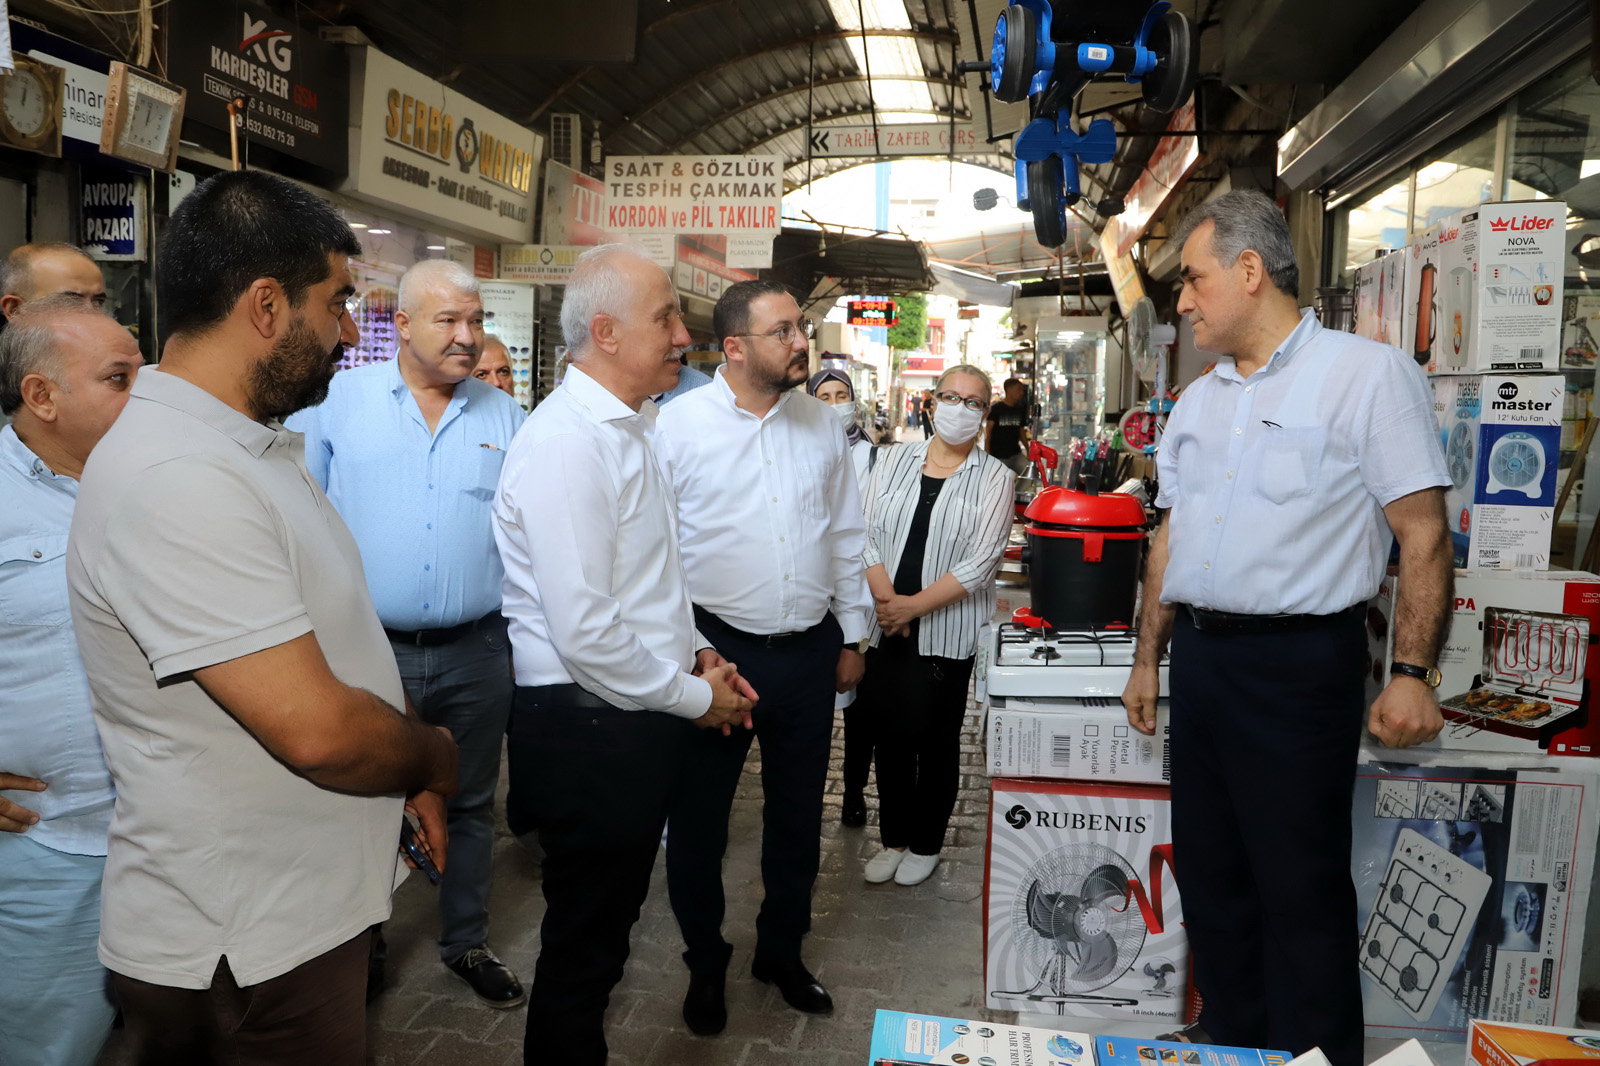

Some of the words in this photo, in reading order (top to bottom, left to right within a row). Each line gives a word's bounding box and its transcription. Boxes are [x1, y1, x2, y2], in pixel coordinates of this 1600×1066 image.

[211, 45, 289, 100] KARDEŞLER
[246, 117, 262, 134] 532
[263, 124, 276, 140] 052
[277, 129, 285, 143] 75
[286, 134, 295, 147] 28
[294, 115, 319, 134] TELEFON
[386, 88, 454, 160] SERBO
[479, 131, 532, 193] WATCH
[887, 130, 930, 147] ZAFER
[613, 162, 664, 177] SAAT
[671, 161, 684, 177] &
[692, 158, 775, 177] GÖZLÜK
[84, 183, 134, 207] AVRUPA
[610, 179, 682, 198] TESPİH
[690, 182, 777, 201] ÇAKMAK
[608, 205, 667, 227] KORDON
[672, 211, 686, 227] ve
[691, 200, 714, 228] PİL
[718, 205, 776, 228] TAKILIR
[1510, 215, 1555, 231] Lider
[87, 217, 133, 241] PAZARI
[1507, 237, 1536, 246] NOVA
[504, 249, 538, 263] SERBO
[1457, 380, 1480, 396] master
[1499, 387, 1517, 395] mtr
[1492, 399, 1552, 411] master
[1511, 414, 1528, 422] Kutu
[1080, 738, 1090, 760] Ayak
[1090, 738, 1101, 775] Yuvarlak
[1109, 739, 1119, 775] Pervane
[1120, 739, 1130, 765] Metal
[1035, 810, 1147, 834] RUBENIS
[1484, 944, 1493, 967] sistemi
[1519, 957, 1527, 980] system
[1502, 962, 1512, 1002] consumption
[1516, 981, 1526, 1002] safety
[1461, 996, 1469, 1008] gaz
[1155, 1010, 1177, 1018] (46cm)
[1008, 1030, 1018, 1047] HAIR
